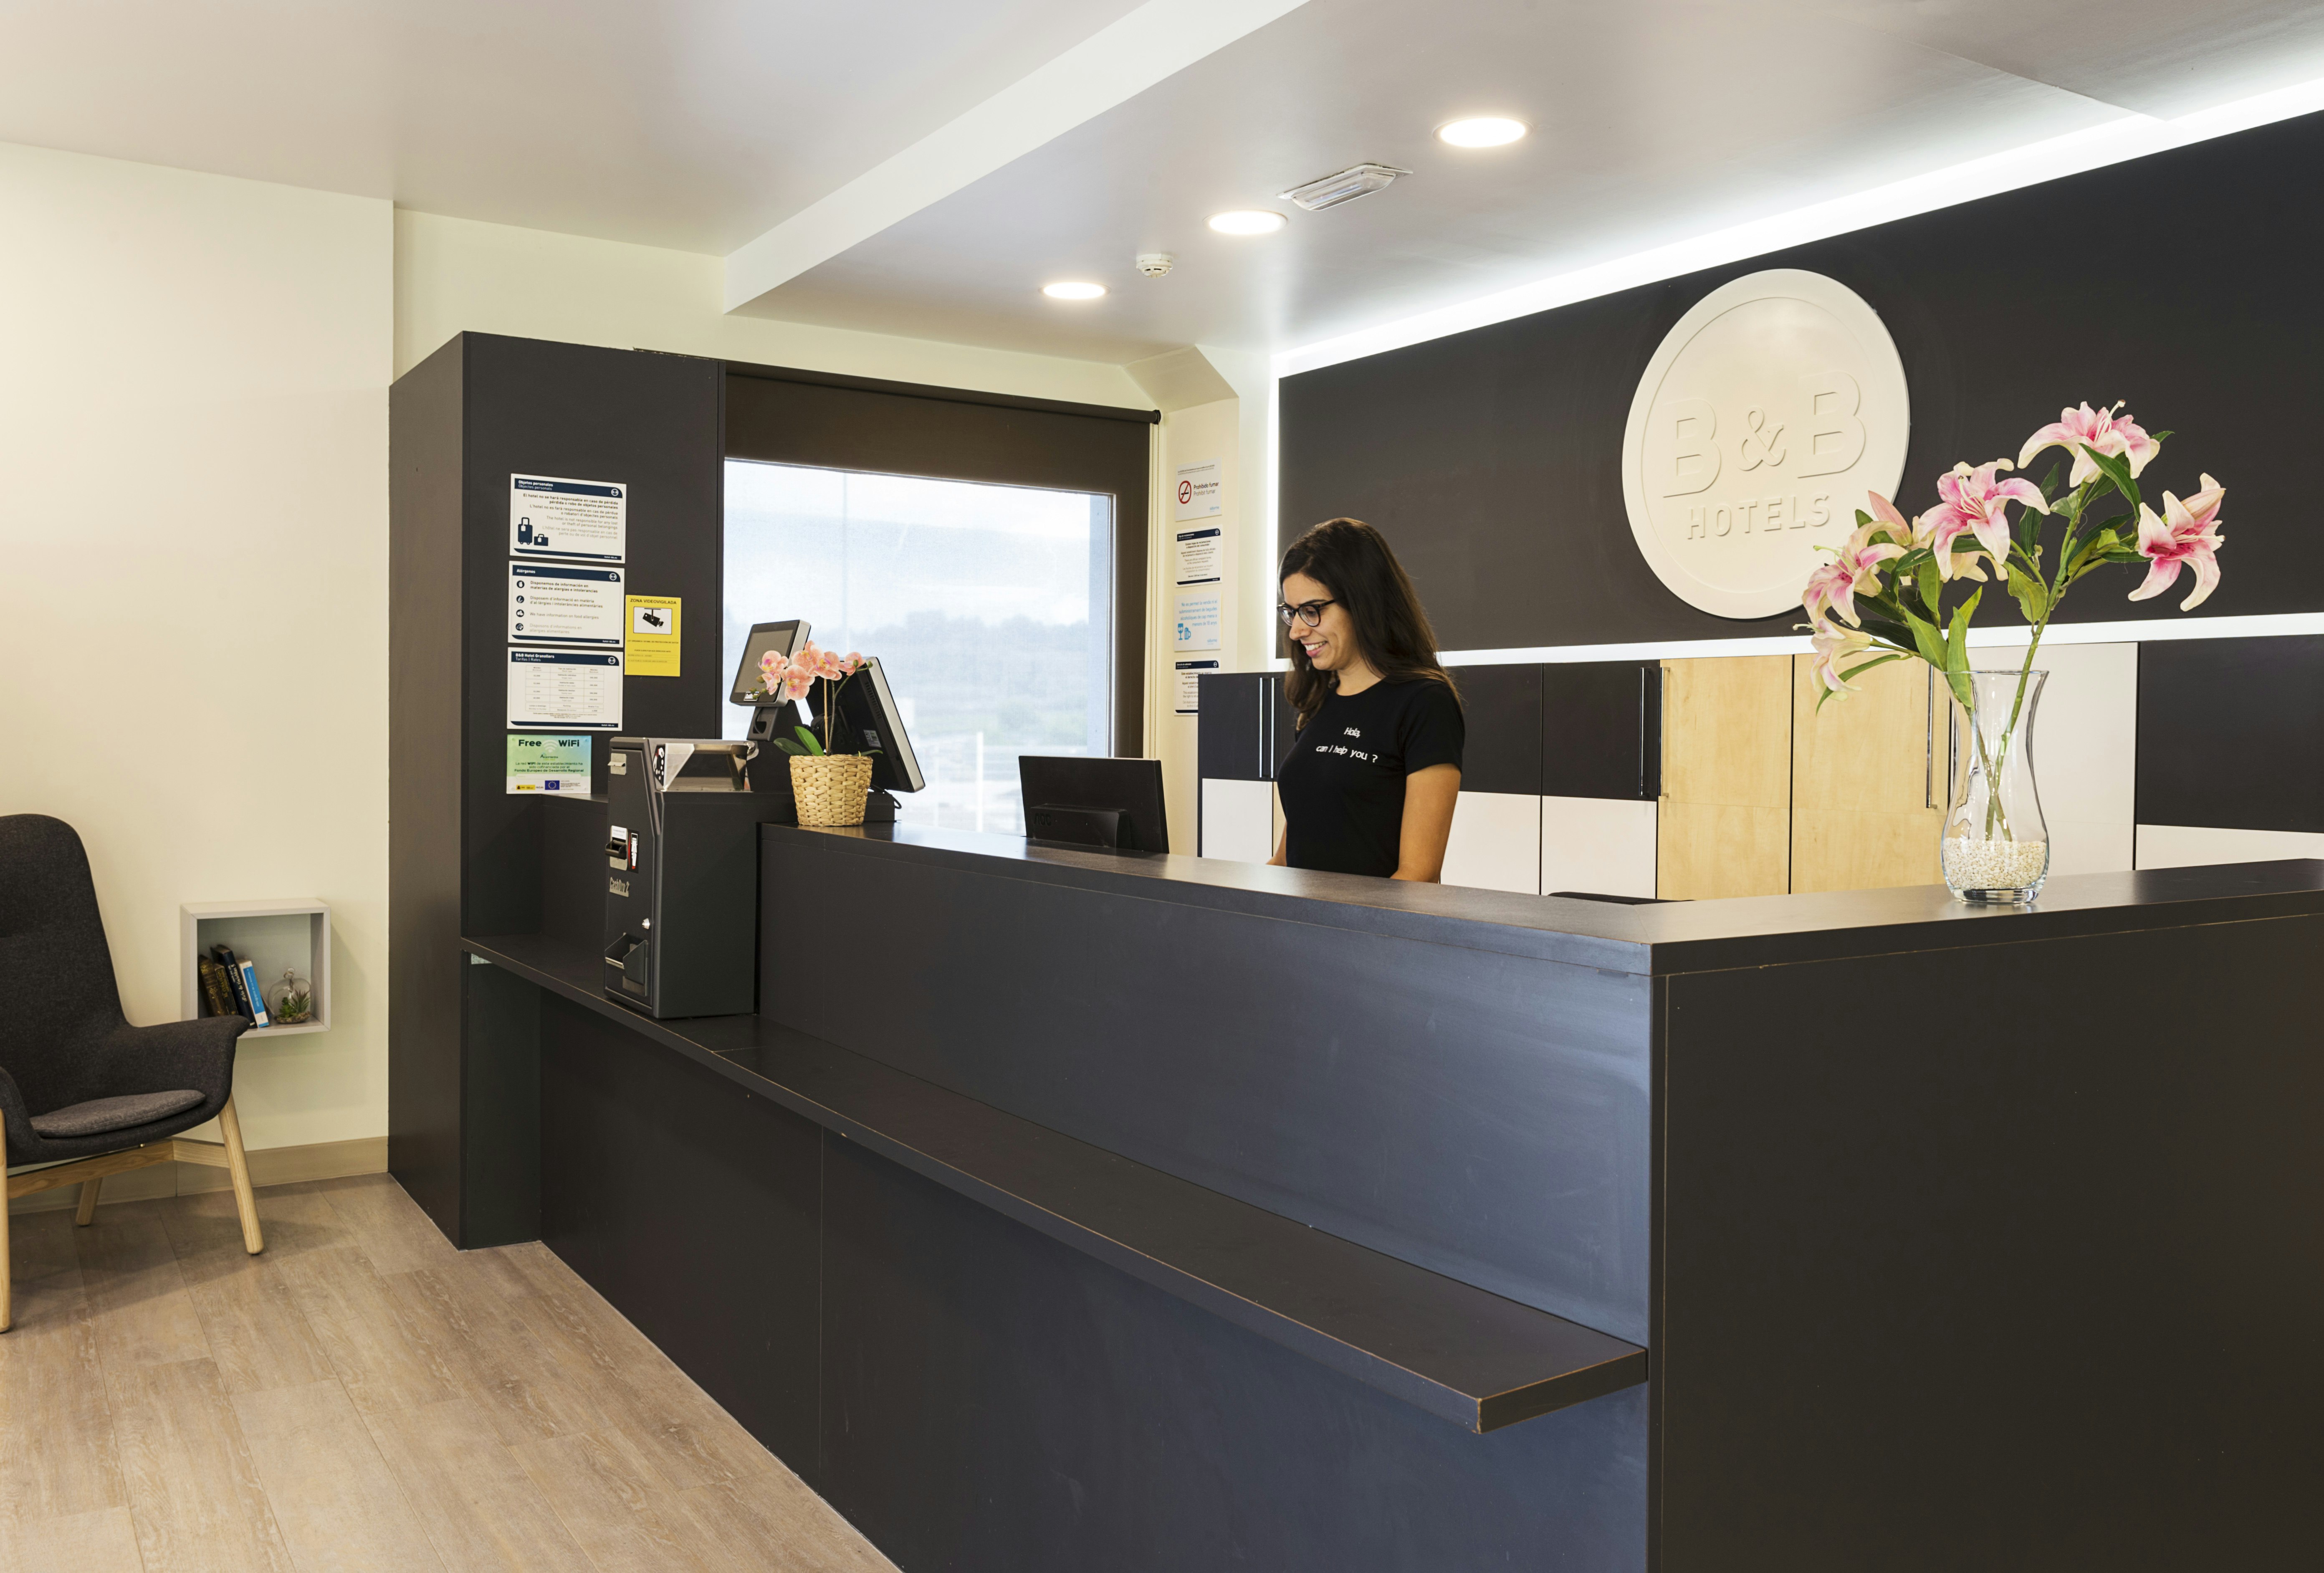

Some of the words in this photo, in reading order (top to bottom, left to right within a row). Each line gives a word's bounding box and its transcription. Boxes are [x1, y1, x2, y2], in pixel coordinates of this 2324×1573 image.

[1662, 370, 1866, 498] B&B
[1687, 494, 1831, 540] HOTELS
[1344, 727, 1361, 738] Hola,
[1333, 746, 1348, 755] help
[1350, 750, 1368, 760] you
[1372, 754, 1378, 763] ?
